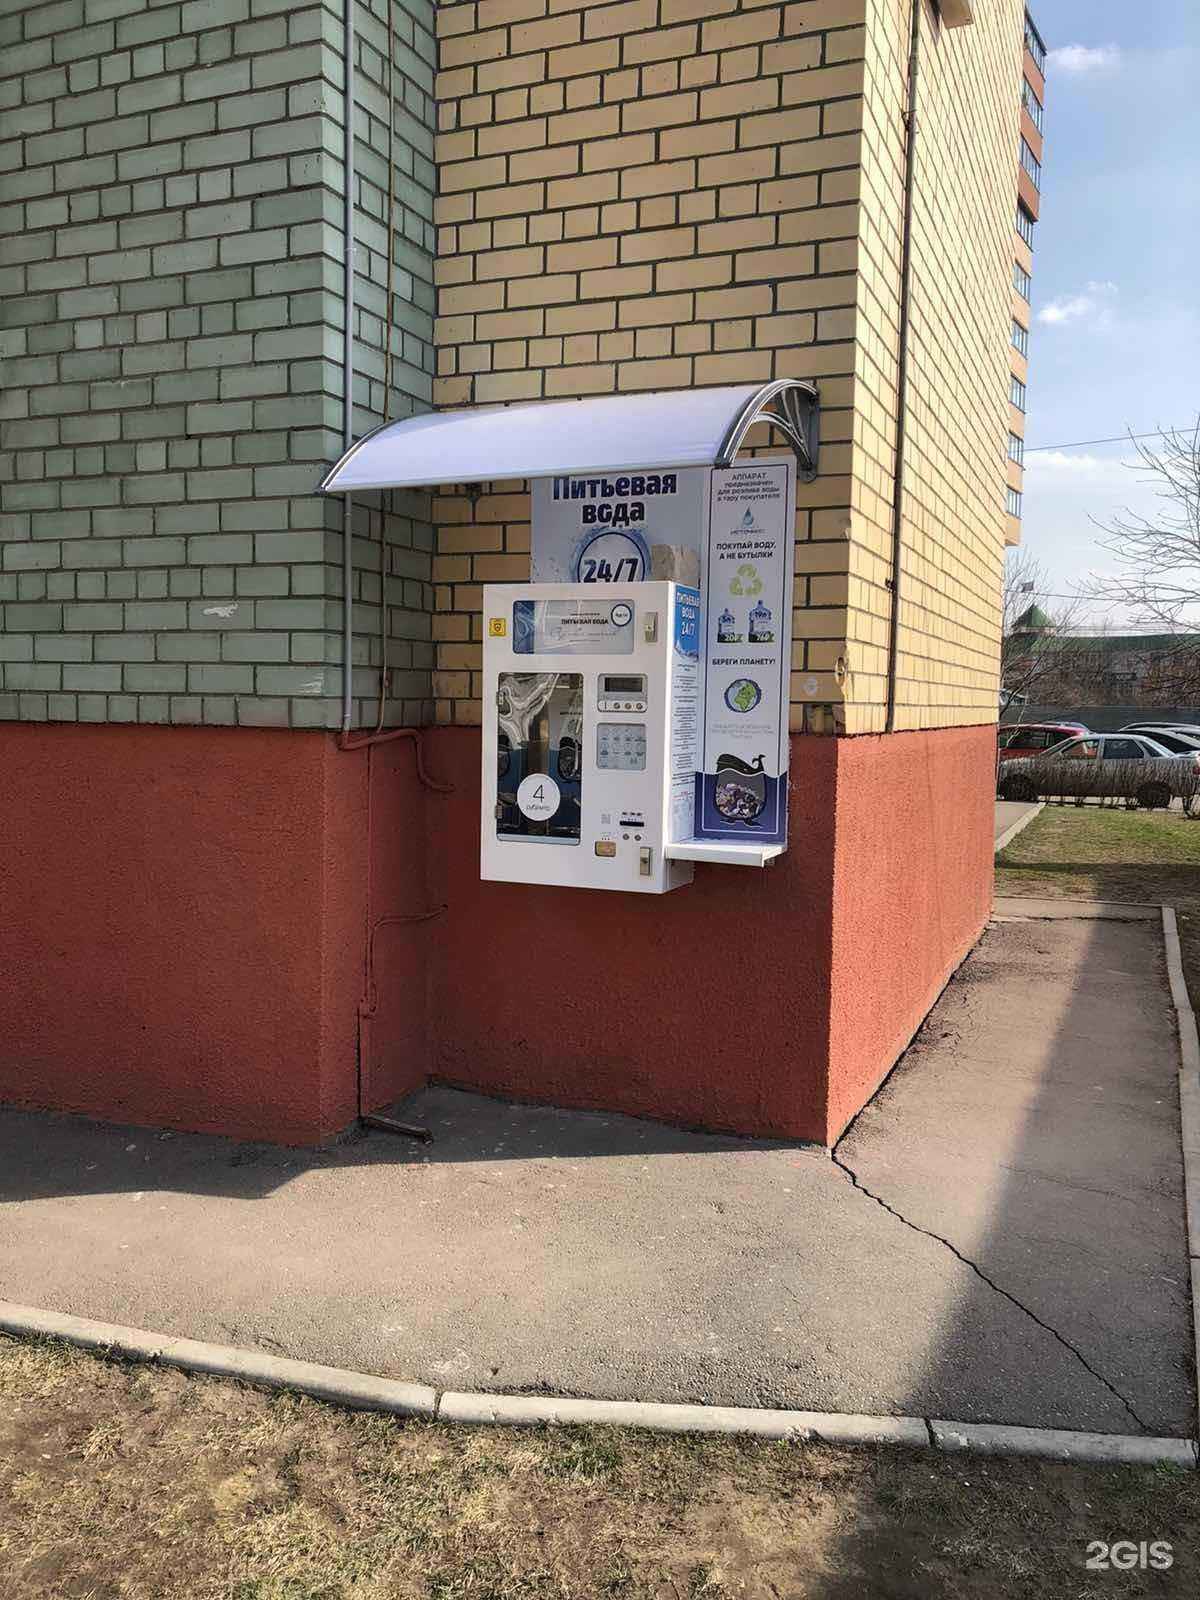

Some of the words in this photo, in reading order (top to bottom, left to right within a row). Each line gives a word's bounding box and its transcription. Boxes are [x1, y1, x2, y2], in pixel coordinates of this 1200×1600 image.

[552, 474, 677, 500] Питьевая
[582, 501, 645, 527] вода
[716, 541, 753, 550] ПОКУПАЙ
[754, 541, 777, 550] ВОДУ,
[719, 552, 725, 560] А
[726, 552, 736, 560] НЕ
[737, 551, 774, 560] БУТЫЛКИ
[583, 557, 639, 583] 24/7
[712, 658, 738, 666] БЕРЕГИ
[739, 658, 776, 666] ПЛАНЕТУ!
[533, 784, 545, 803] 4
